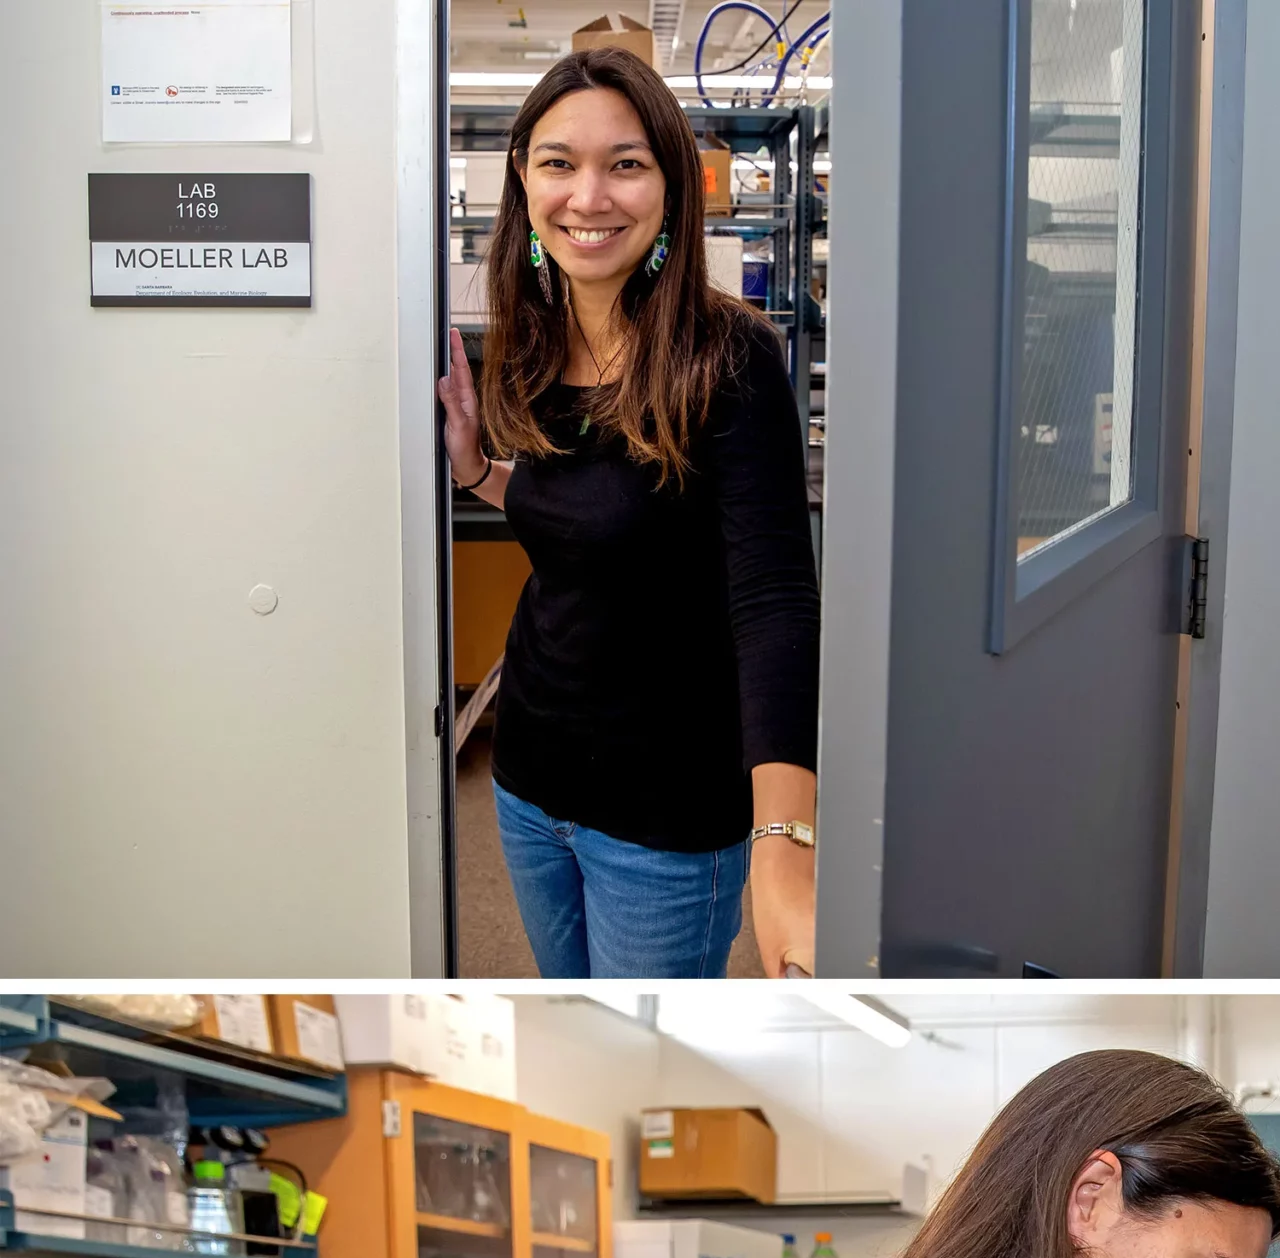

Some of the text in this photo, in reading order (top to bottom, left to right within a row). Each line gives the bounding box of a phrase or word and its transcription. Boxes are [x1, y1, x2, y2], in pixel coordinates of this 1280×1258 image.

[178, 183, 216, 199] LAB
[176, 202, 218, 218] 1169
[115, 248, 288, 269] MOELLER LAB
